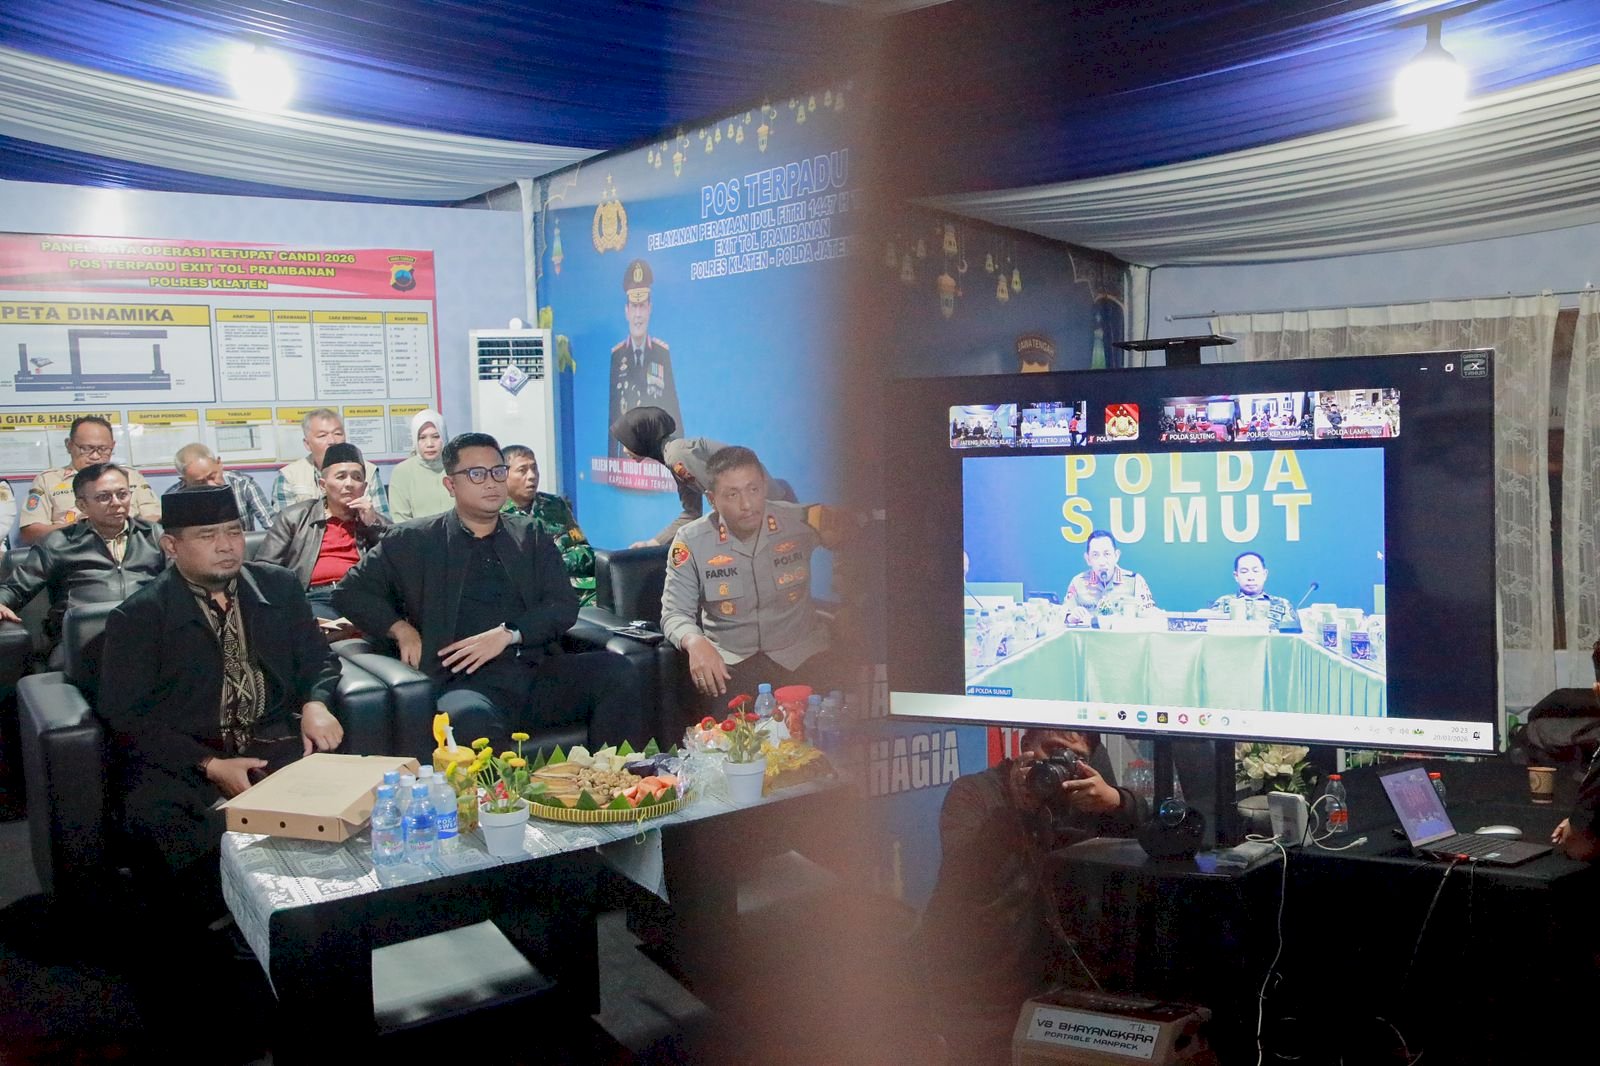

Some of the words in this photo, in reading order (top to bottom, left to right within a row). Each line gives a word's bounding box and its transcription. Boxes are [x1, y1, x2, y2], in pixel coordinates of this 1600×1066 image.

[702, 178, 740, 219] POS
[744, 148, 849, 208] TERPADU
[647, 225, 698, 251] PELAYANAN
[699, 214, 750, 241] PERAYAAN
[751, 207, 775, 226] IDUL
[777, 201, 806, 221] FITRI
[714, 237, 738, 258] EXIT
[739, 234, 759, 253] TOL
[761, 217, 830, 249] PRAMBANAN
[41, 242, 92, 253] PANEL
[142, 245, 206, 257] OPERASI
[210, 248, 274, 261] KETUPAT
[279, 250, 321, 262] CANDI
[325, 253, 356, 264] 2026
[691, 257, 727, 280] POLRES
[729, 251, 768, 275] KLATEN
[776, 243, 813, 267] POLDA
[68, 259, 101, 269] POS
[105, 260, 176, 272] TERPADU
[180, 262, 214, 273] EXIT
[218, 263, 245, 274] TOL
[249, 265, 336, 277] PRAMBANAN
[149, 277, 208, 288] POLRES
[211, 279, 268, 290] KLATEN
[1, 306, 60, 321] PETA
[68, 307, 175, 322] DINAMIKA
[6, 415, 33, 424] GIAT
[37, 415, 45, 423] &
[1169, 433, 1188, 441] POLDA
[1327, 428, 1347, 436] POLDA
[1348, 427, 1382, 435] LAMPUNG
[1065, 449, 1308, 496] POLDA
[1060, 493, 1312, 544] SUMUT
[773, 552, 803, 568] POLRI
[705, 567, 738, 580] FARUK
[975, 687, 992, 695] POLDA
[993, 688, 1012, 696] SUMUT
[1044, 1031, 1091, 1043] PORTABLE
[1093, 1038, 1138, 1051] MANPACK
[1058, 1022, 1154, 1044] BHAYANGKARA
